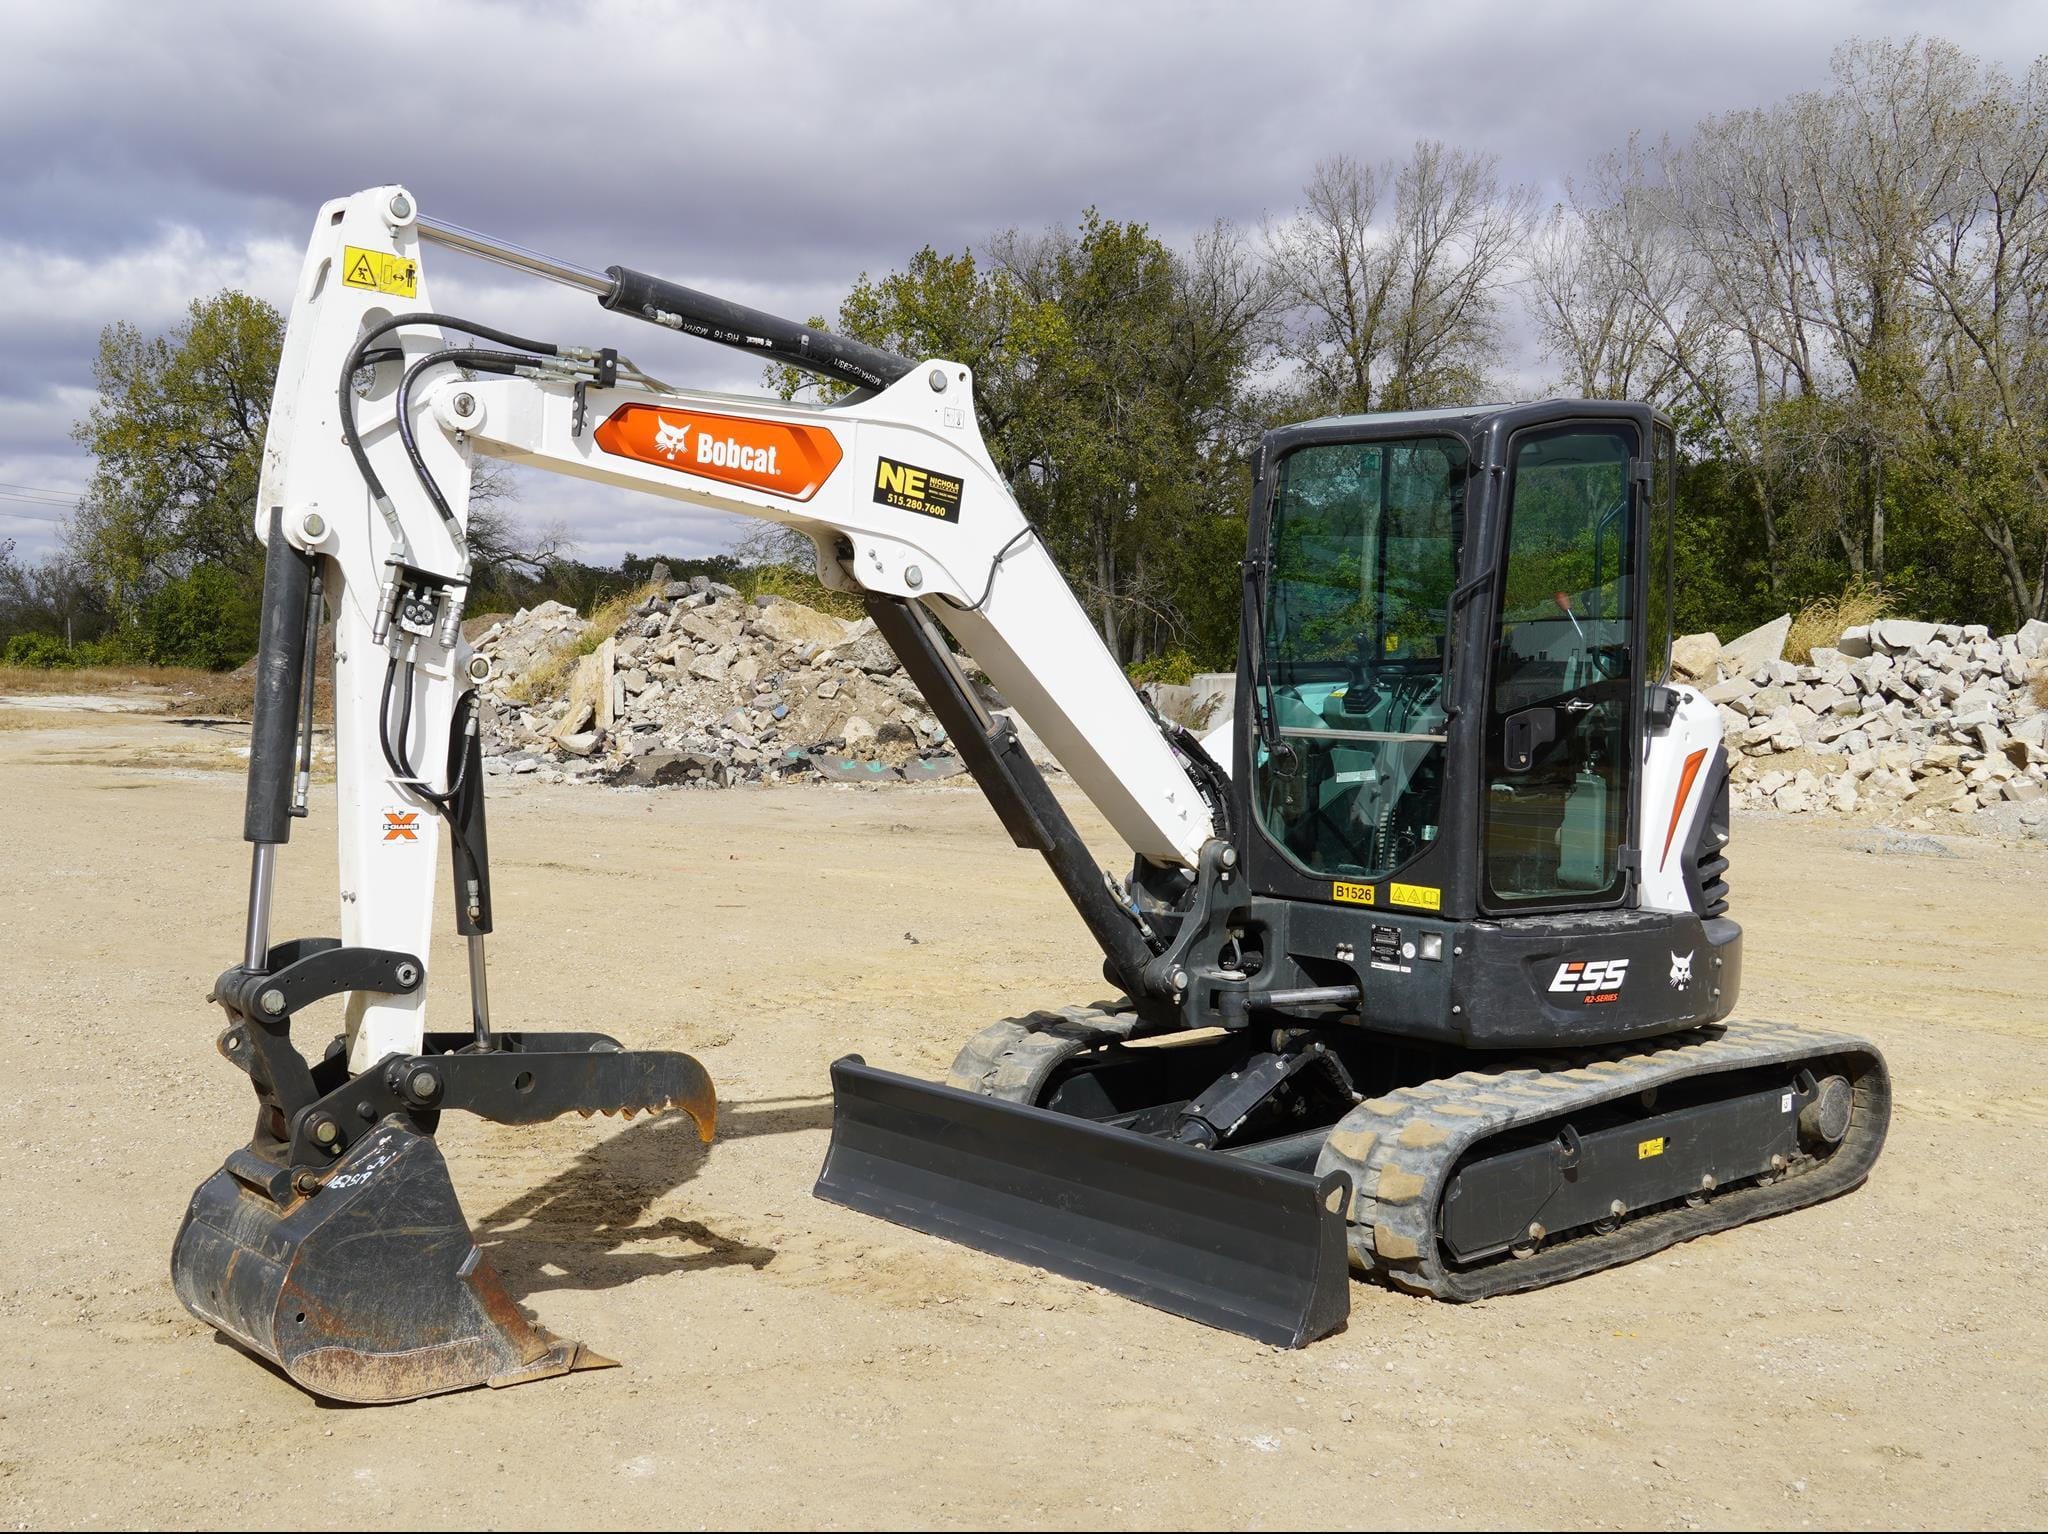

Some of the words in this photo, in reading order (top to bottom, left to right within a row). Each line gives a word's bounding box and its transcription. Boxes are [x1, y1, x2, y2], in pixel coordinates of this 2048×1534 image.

[683, 323, 709, 335] MSHA
[714, 329, 740, 342] HG-16
[696, 432, 777, 475] Bobcat
[878, 461, 928, 499] NE
[929, 476, 959, 490] NICHOLS
[887, 493, 946, 517] 515.280.7600
[1336, 885, 1372, 901] B1526
[1548, 959, 1630, 992] E55
[1583, 993, 1619, 1004] R2-SERIES
